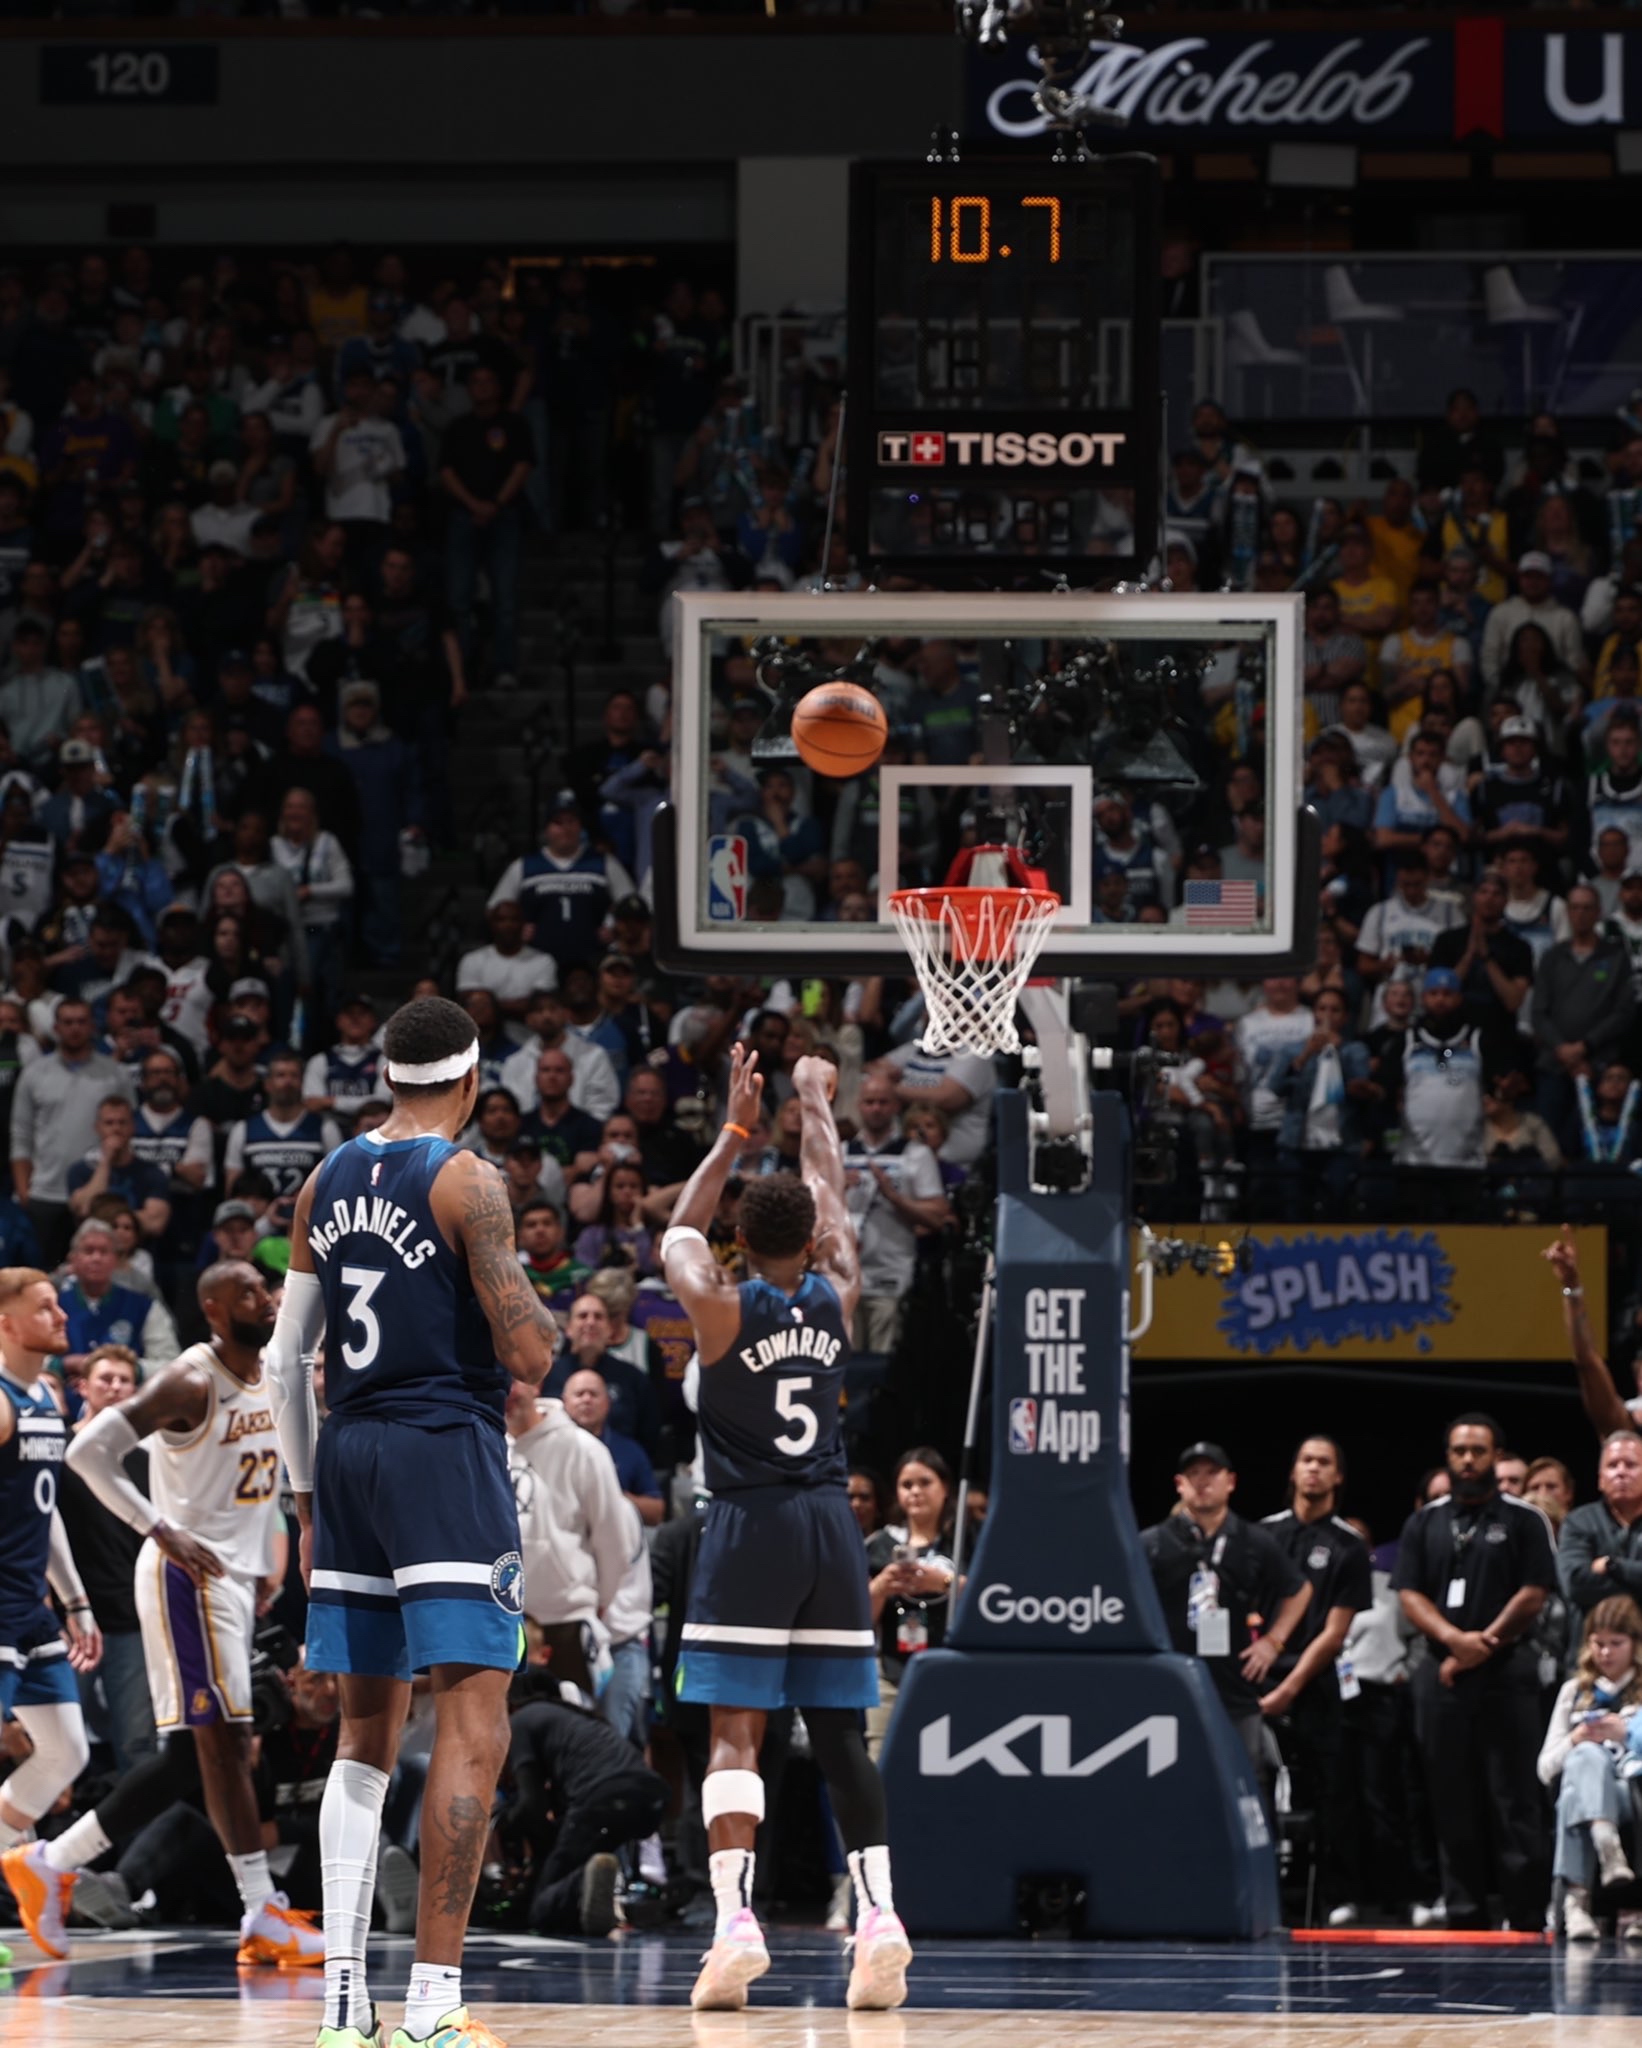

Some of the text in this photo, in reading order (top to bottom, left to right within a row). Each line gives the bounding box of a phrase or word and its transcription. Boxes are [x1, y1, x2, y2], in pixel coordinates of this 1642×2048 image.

[86, 53, 170, 95] 120
[986, 38, 1433, 137] Michelob
[930, 196, 1060, 263] 10.7
[946, 432, 1126, 466] TISSOT
[559, 896, 571, 922] 1
[308, 1195, 437, 1270] McDANIELS
[341, 1265, 386, 1371] 3
[1025, 1288, 1086, 1340] GET
[1240, 1252, 1430, 1330] SPLASH
[739, 1326, 842, 1373] EDWARDS
[1024, 1344, 1086, 1395] THE
[773, 1376, 819, 1456] 5
[1037, 1399, 1100, 1464] App
[34, 1468, 57, 1514] 0
[235, 1450, 278, 1504] 23
[978, 1582, 1125, 1634] Google
[919, 1713, 1178, 1778] KIA
